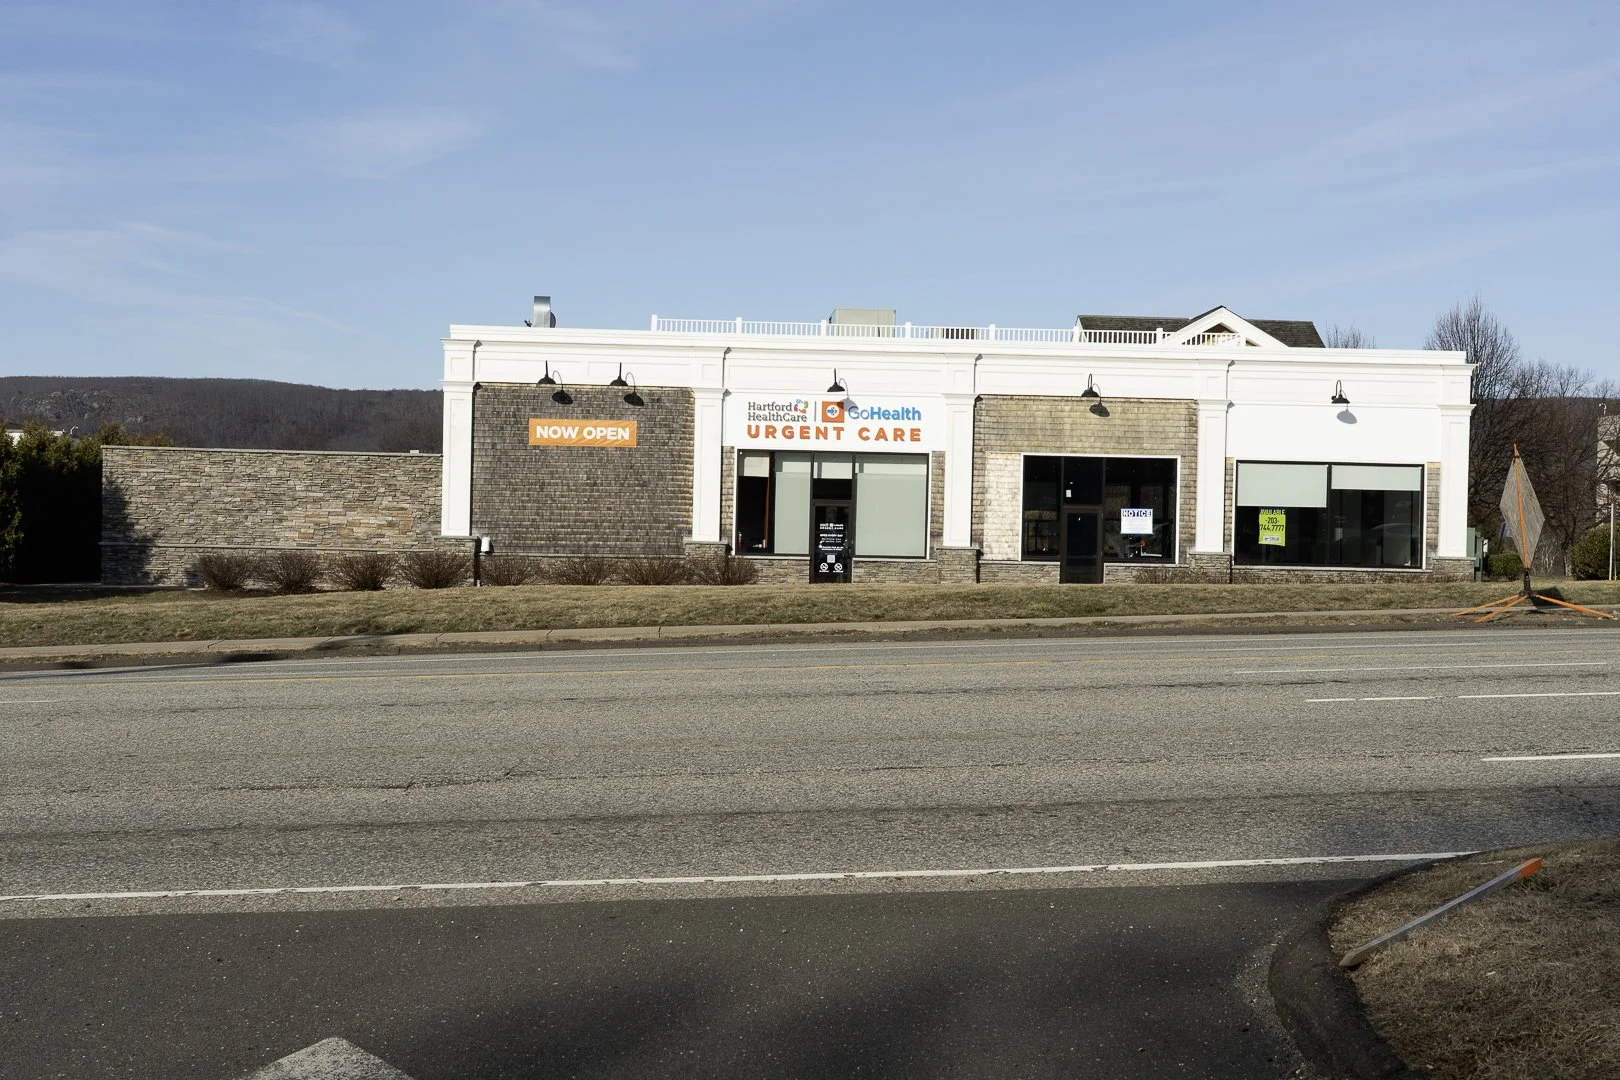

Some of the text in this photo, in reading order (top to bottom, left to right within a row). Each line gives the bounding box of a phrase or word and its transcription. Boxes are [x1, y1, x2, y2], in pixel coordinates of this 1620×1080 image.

[748, 401, 793, 412] Hartford
[848, 406, 922, 420] GoHealth
[747, 412, 808, 422] HealthCare
[536, 425, 630, 440] NOW OPEN
[747, 424, 922, 441] URGENT CARE
